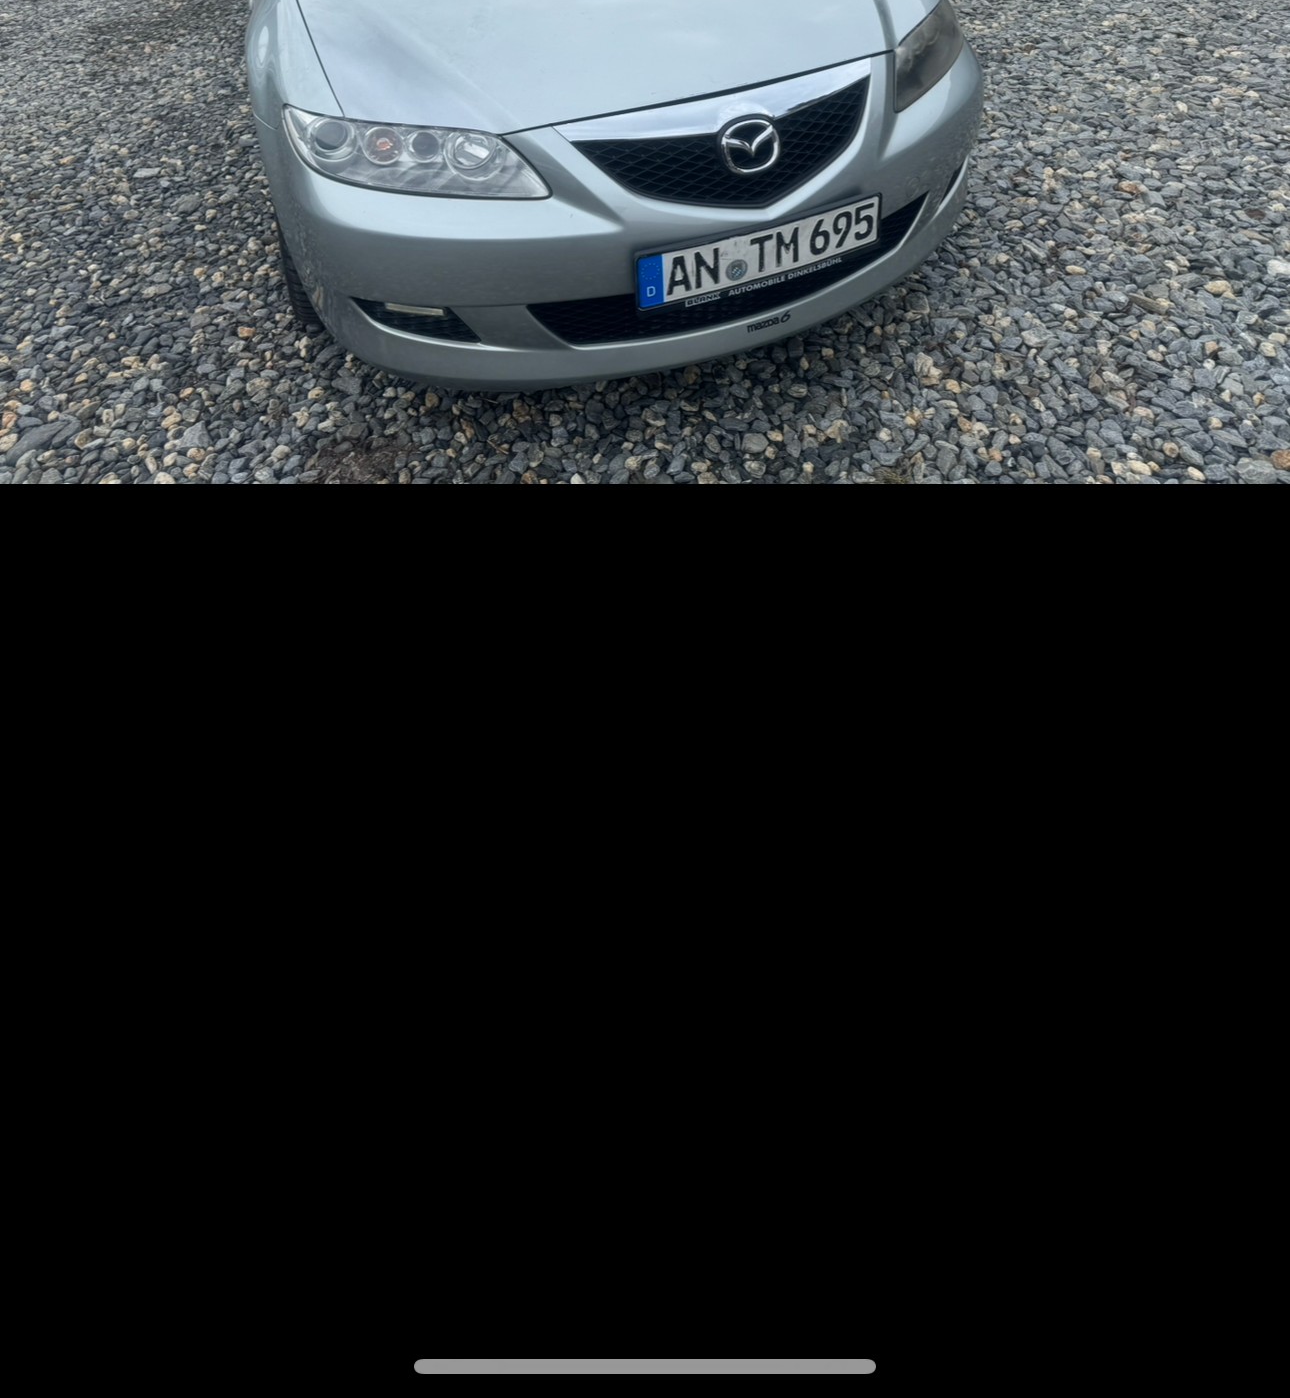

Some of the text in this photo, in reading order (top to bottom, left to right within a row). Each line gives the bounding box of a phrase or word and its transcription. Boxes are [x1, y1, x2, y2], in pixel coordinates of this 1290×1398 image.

[666, 202, 875, 296] AN TM 695
[646, 286, 656, 298] D
[728, 275, 786, 297] AUTOMOBILE
[788, 256, 843, 280] DINKELSBÜHL
